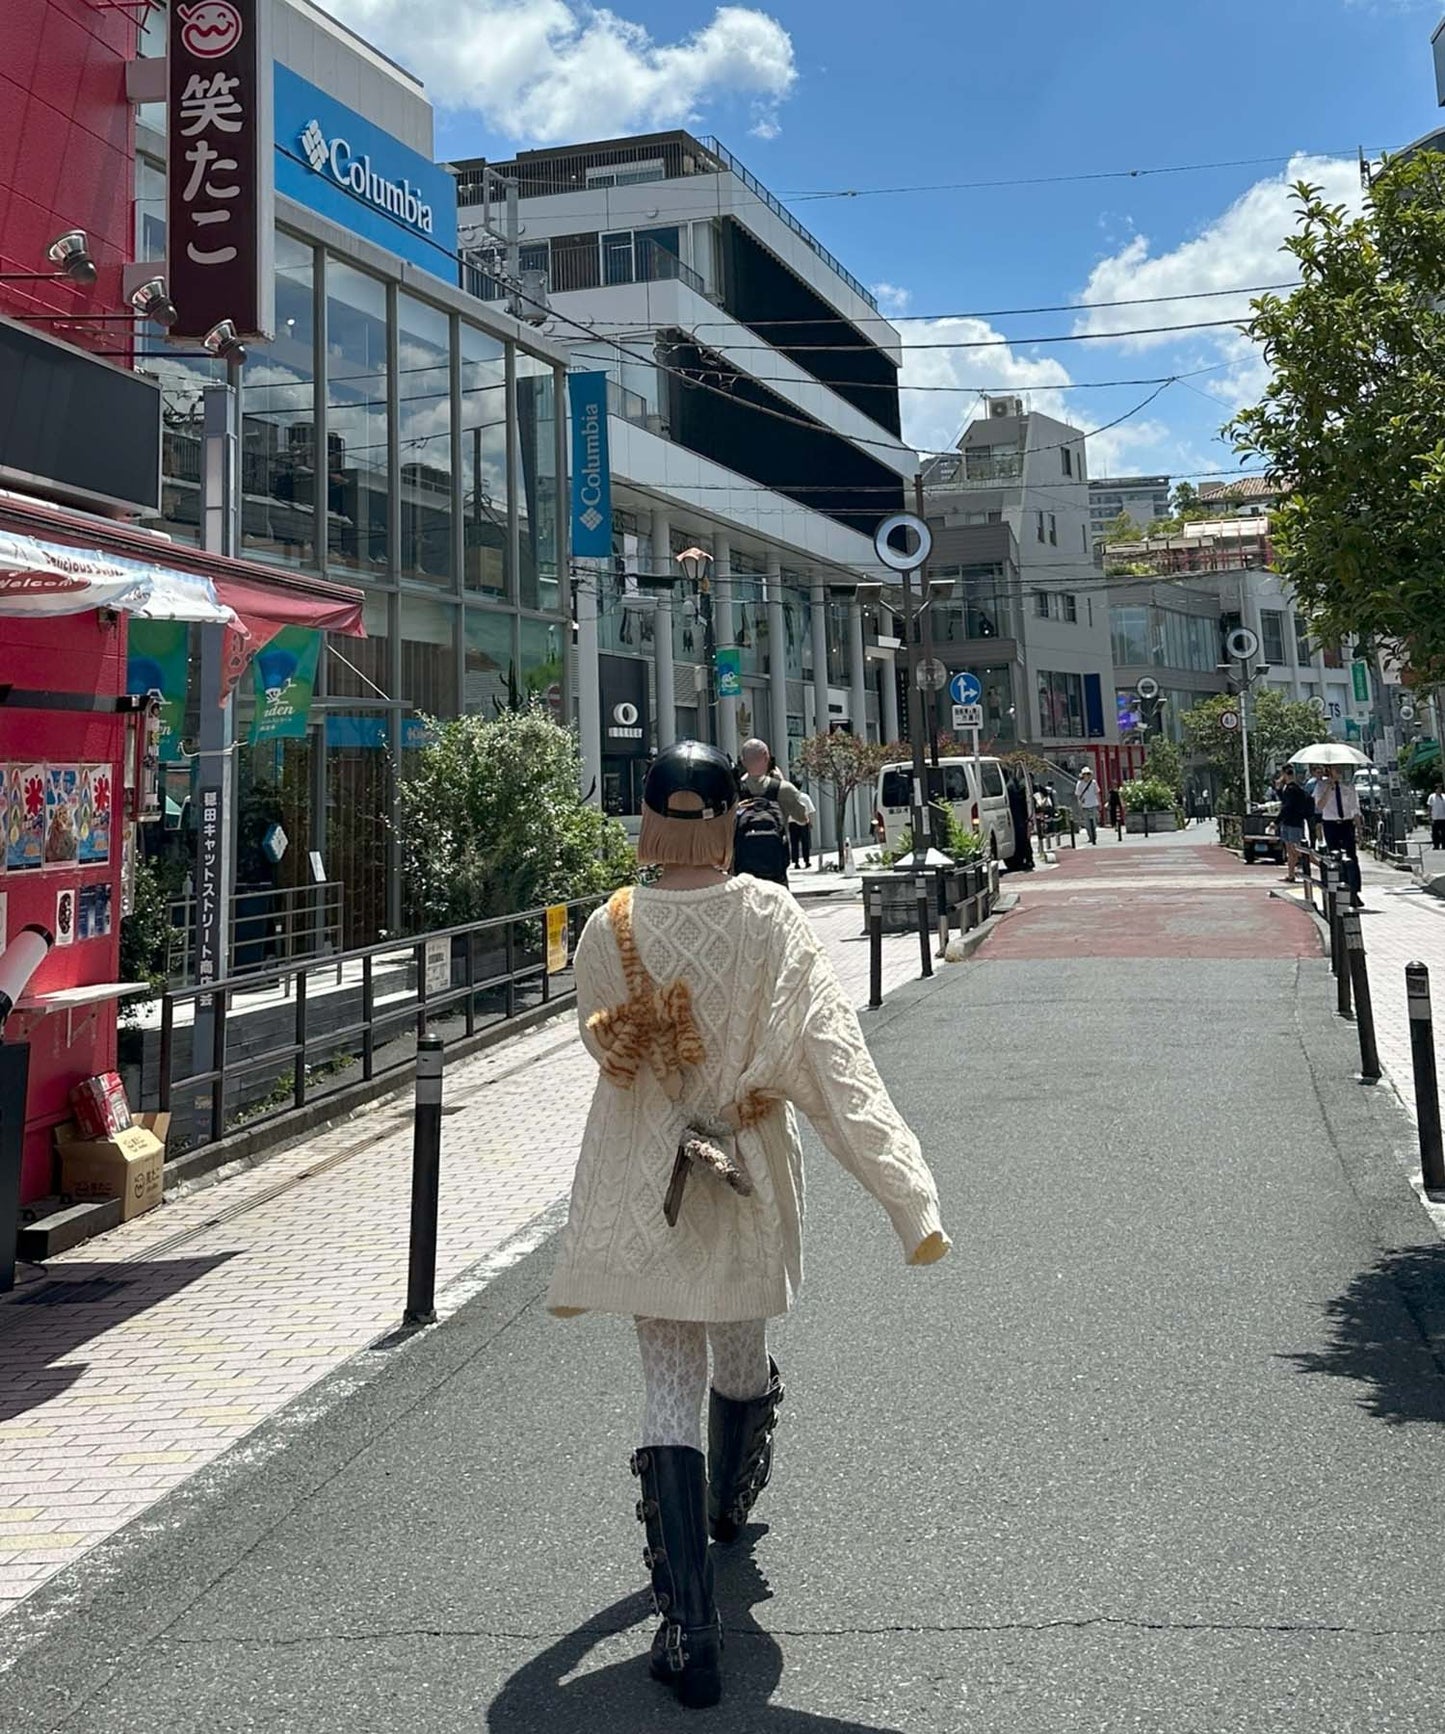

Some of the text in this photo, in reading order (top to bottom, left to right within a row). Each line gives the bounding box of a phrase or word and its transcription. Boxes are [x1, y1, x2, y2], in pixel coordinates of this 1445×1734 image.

[180, 71, 244, 265] 笑たこ
[330, 138, 433, 233] Columbia
[580, 403, 602, 506] Columbia
